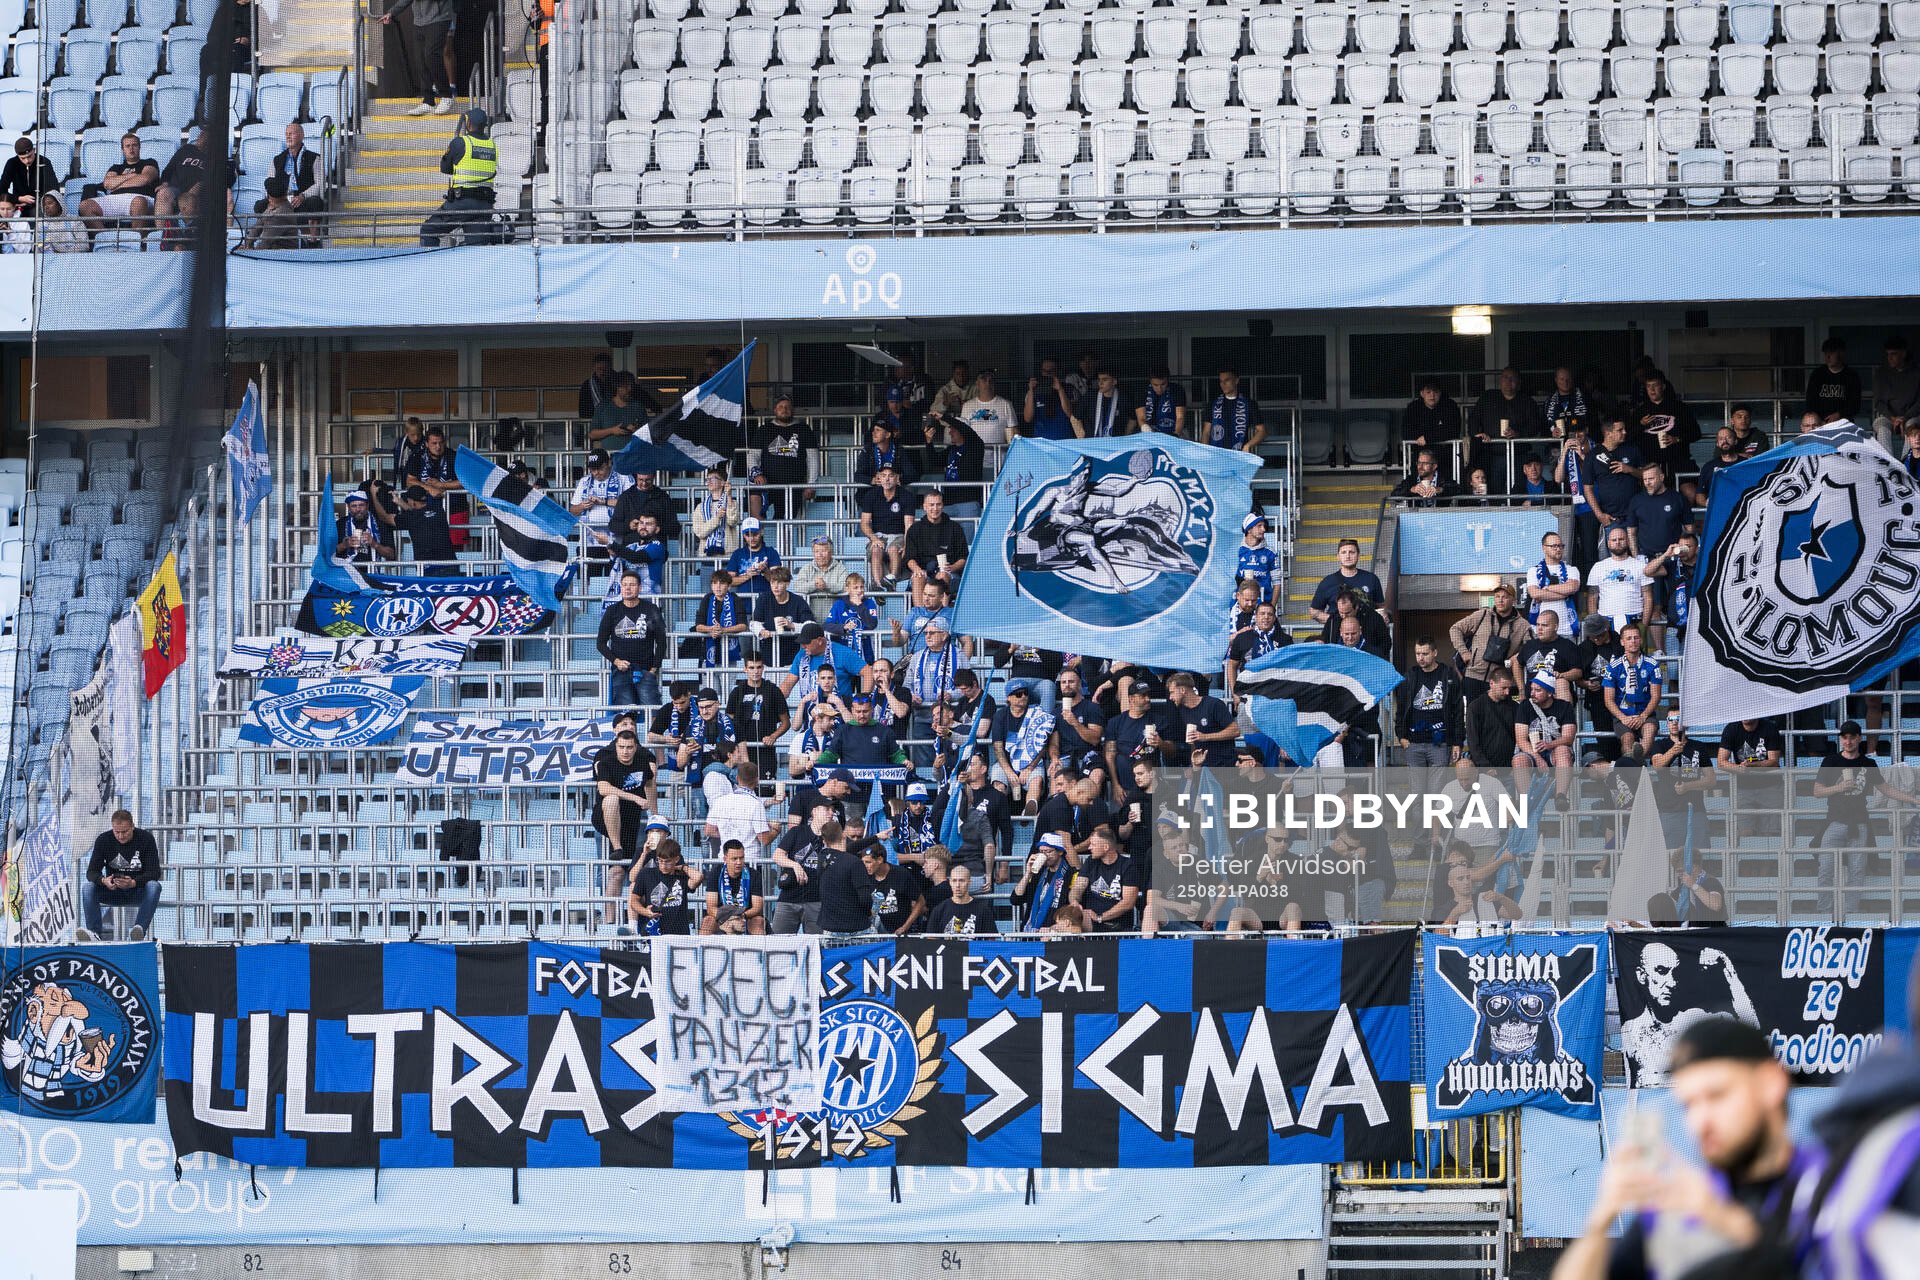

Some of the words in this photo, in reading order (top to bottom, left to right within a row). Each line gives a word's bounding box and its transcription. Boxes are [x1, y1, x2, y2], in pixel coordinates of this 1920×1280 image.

[822, 272, 903, 311] ApQ
[426, 721, 602, 743] SIGMA
[406, 744, 600, 784] ULTRAS
[535, 956, 653, 999] FOTBA
[863, 944, 946, 993] NENÍ
[961, 955, 1106, 994] FOTBAL
[33, 960, 61, 982] OF
[68, 960, 151, 1074] PANORAMIX
[1802, 980, 1843, 1021] ze
[670, 1012, 814, 1072] PANZER
[847, 1007, 905, 1043] SIGMA
[192, 1008, 658, 1134] ULTRAS
[948, 1002, 1391, 1136] SIGMA
[690, 1067, 793, 1107] 1312
[72, 1074, 121, 1108] 1919
[756, 1114, 868, 1160] 1919
[112, 1179, 271, 1230] group
[243, 1253, 265, 1272] 82
[608, 1252, 632, 1273] 83
[941, 1249, 963, 1271] 84
